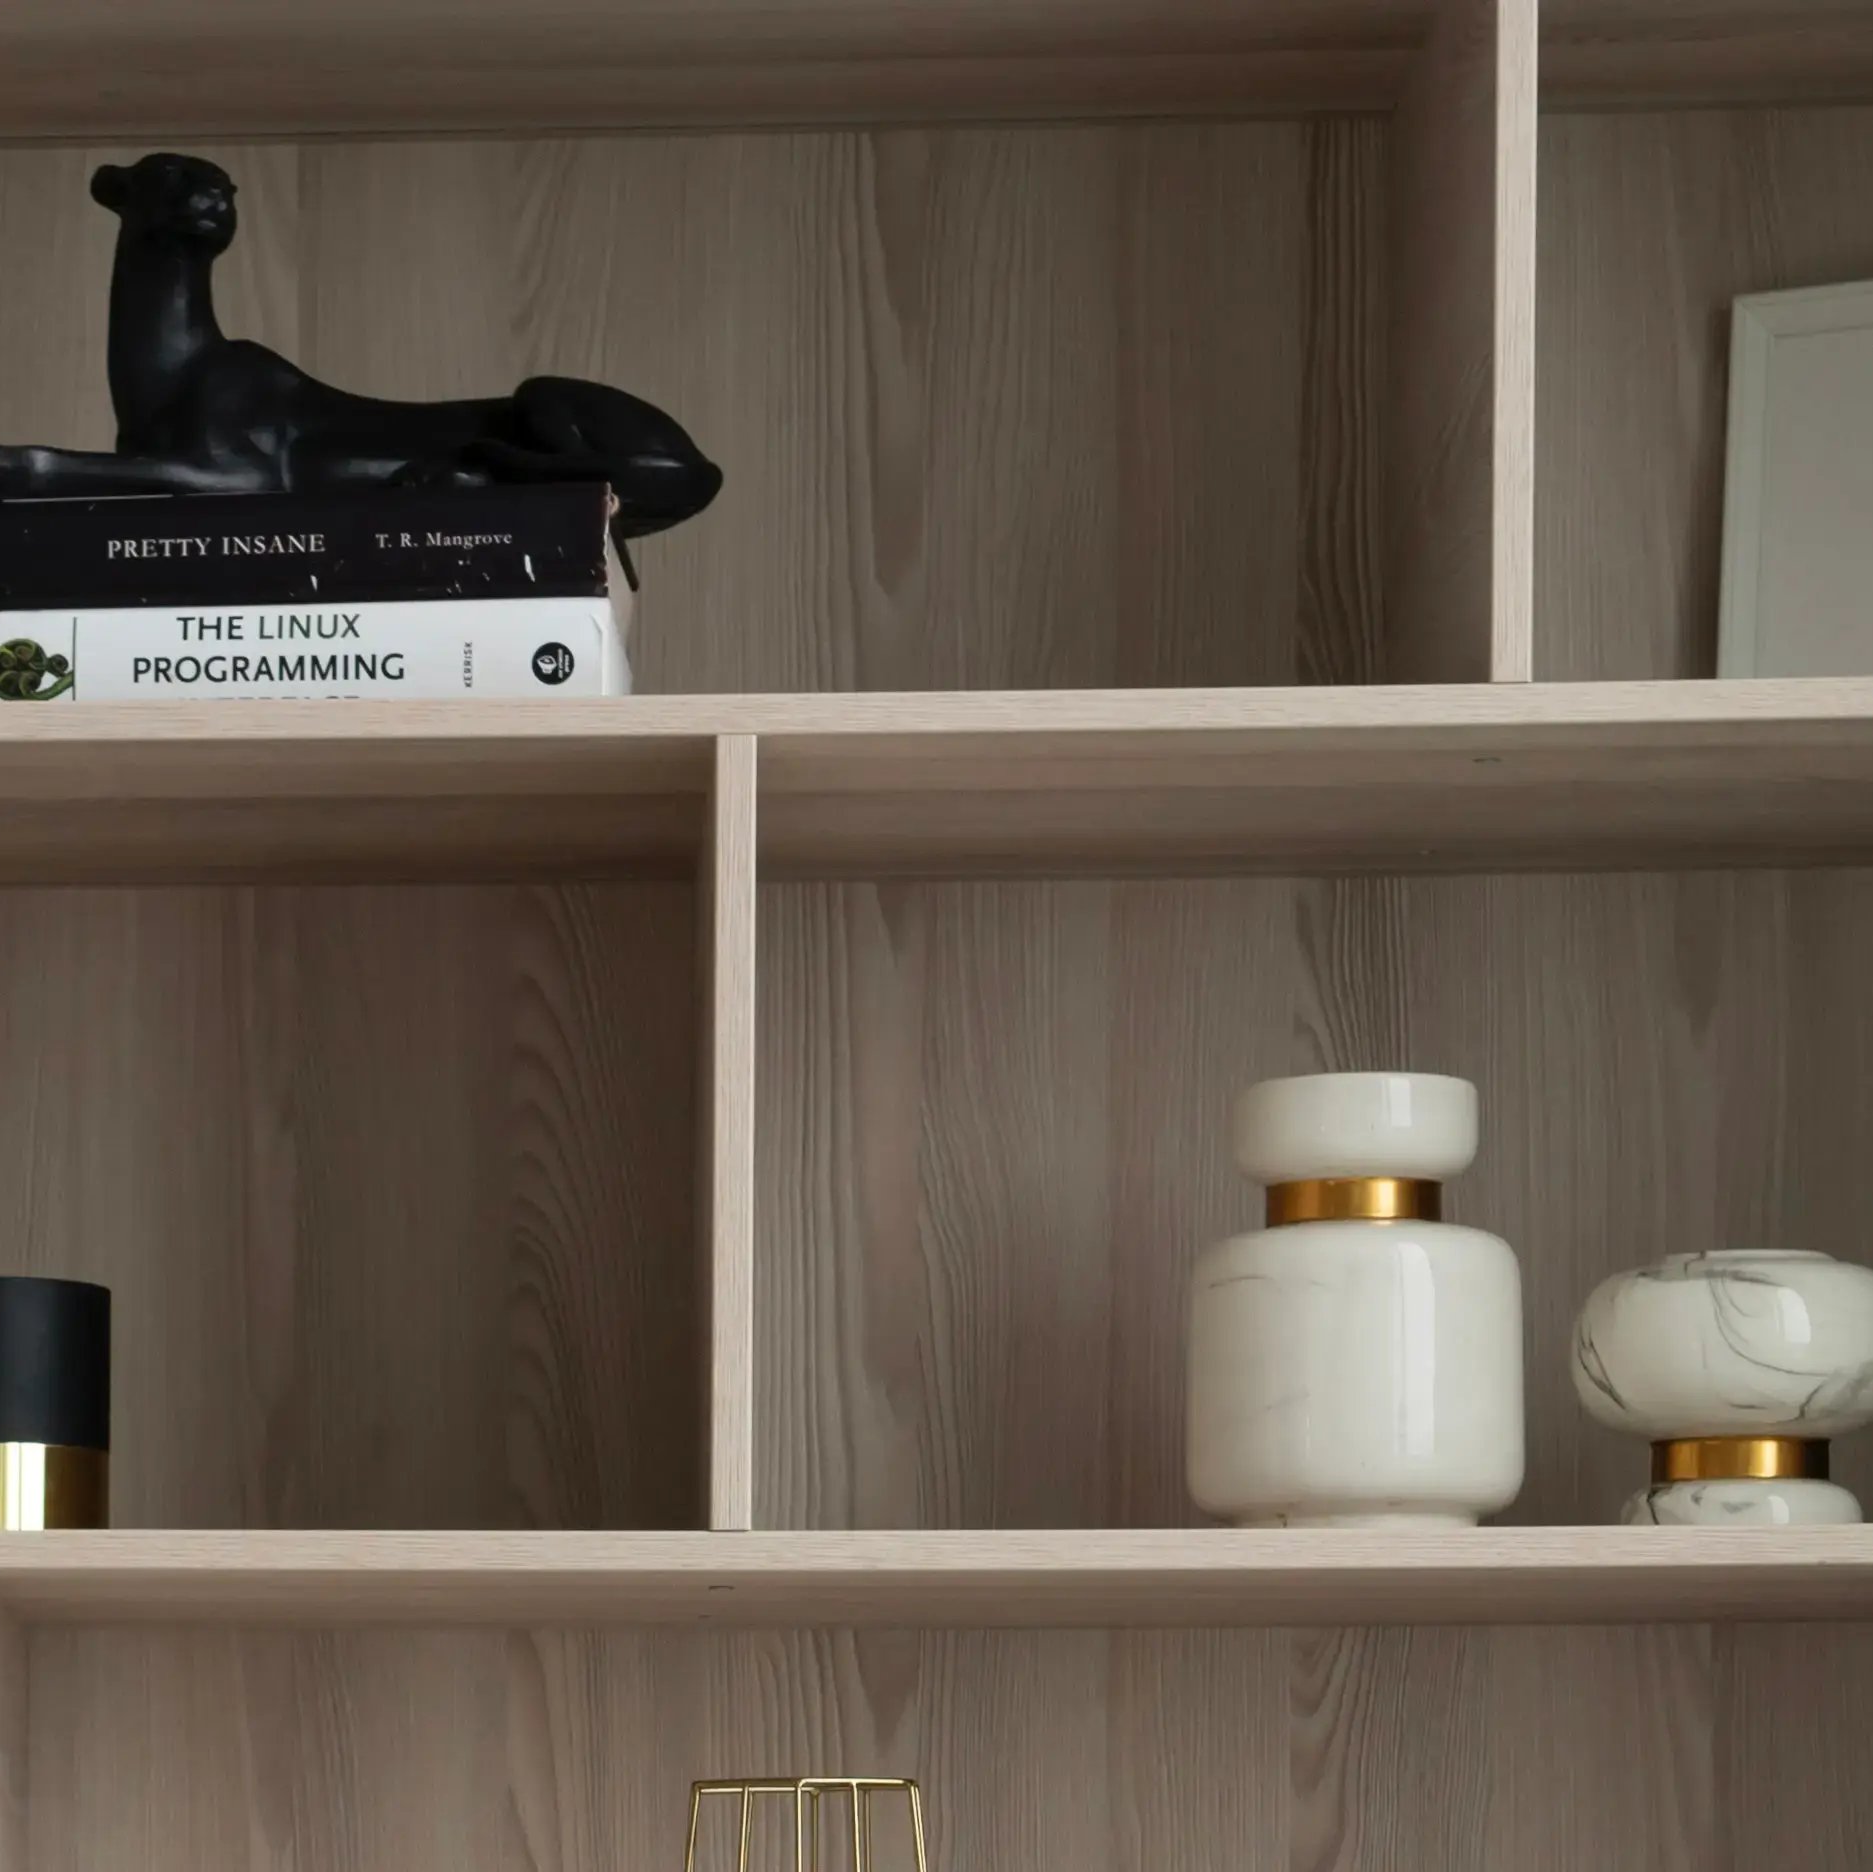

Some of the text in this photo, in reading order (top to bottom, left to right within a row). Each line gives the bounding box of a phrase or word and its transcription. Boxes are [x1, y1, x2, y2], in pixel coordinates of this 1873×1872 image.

[107, 534, 326, 559] PRETTY INSANE
[375, 532, 513, 550] T. R. Mangrove
[176, 613, 361, 641] THE LINUX
[133, 653, 405, 683] PROGRAMMING
[463, 641, 473, 688] KERRISK
